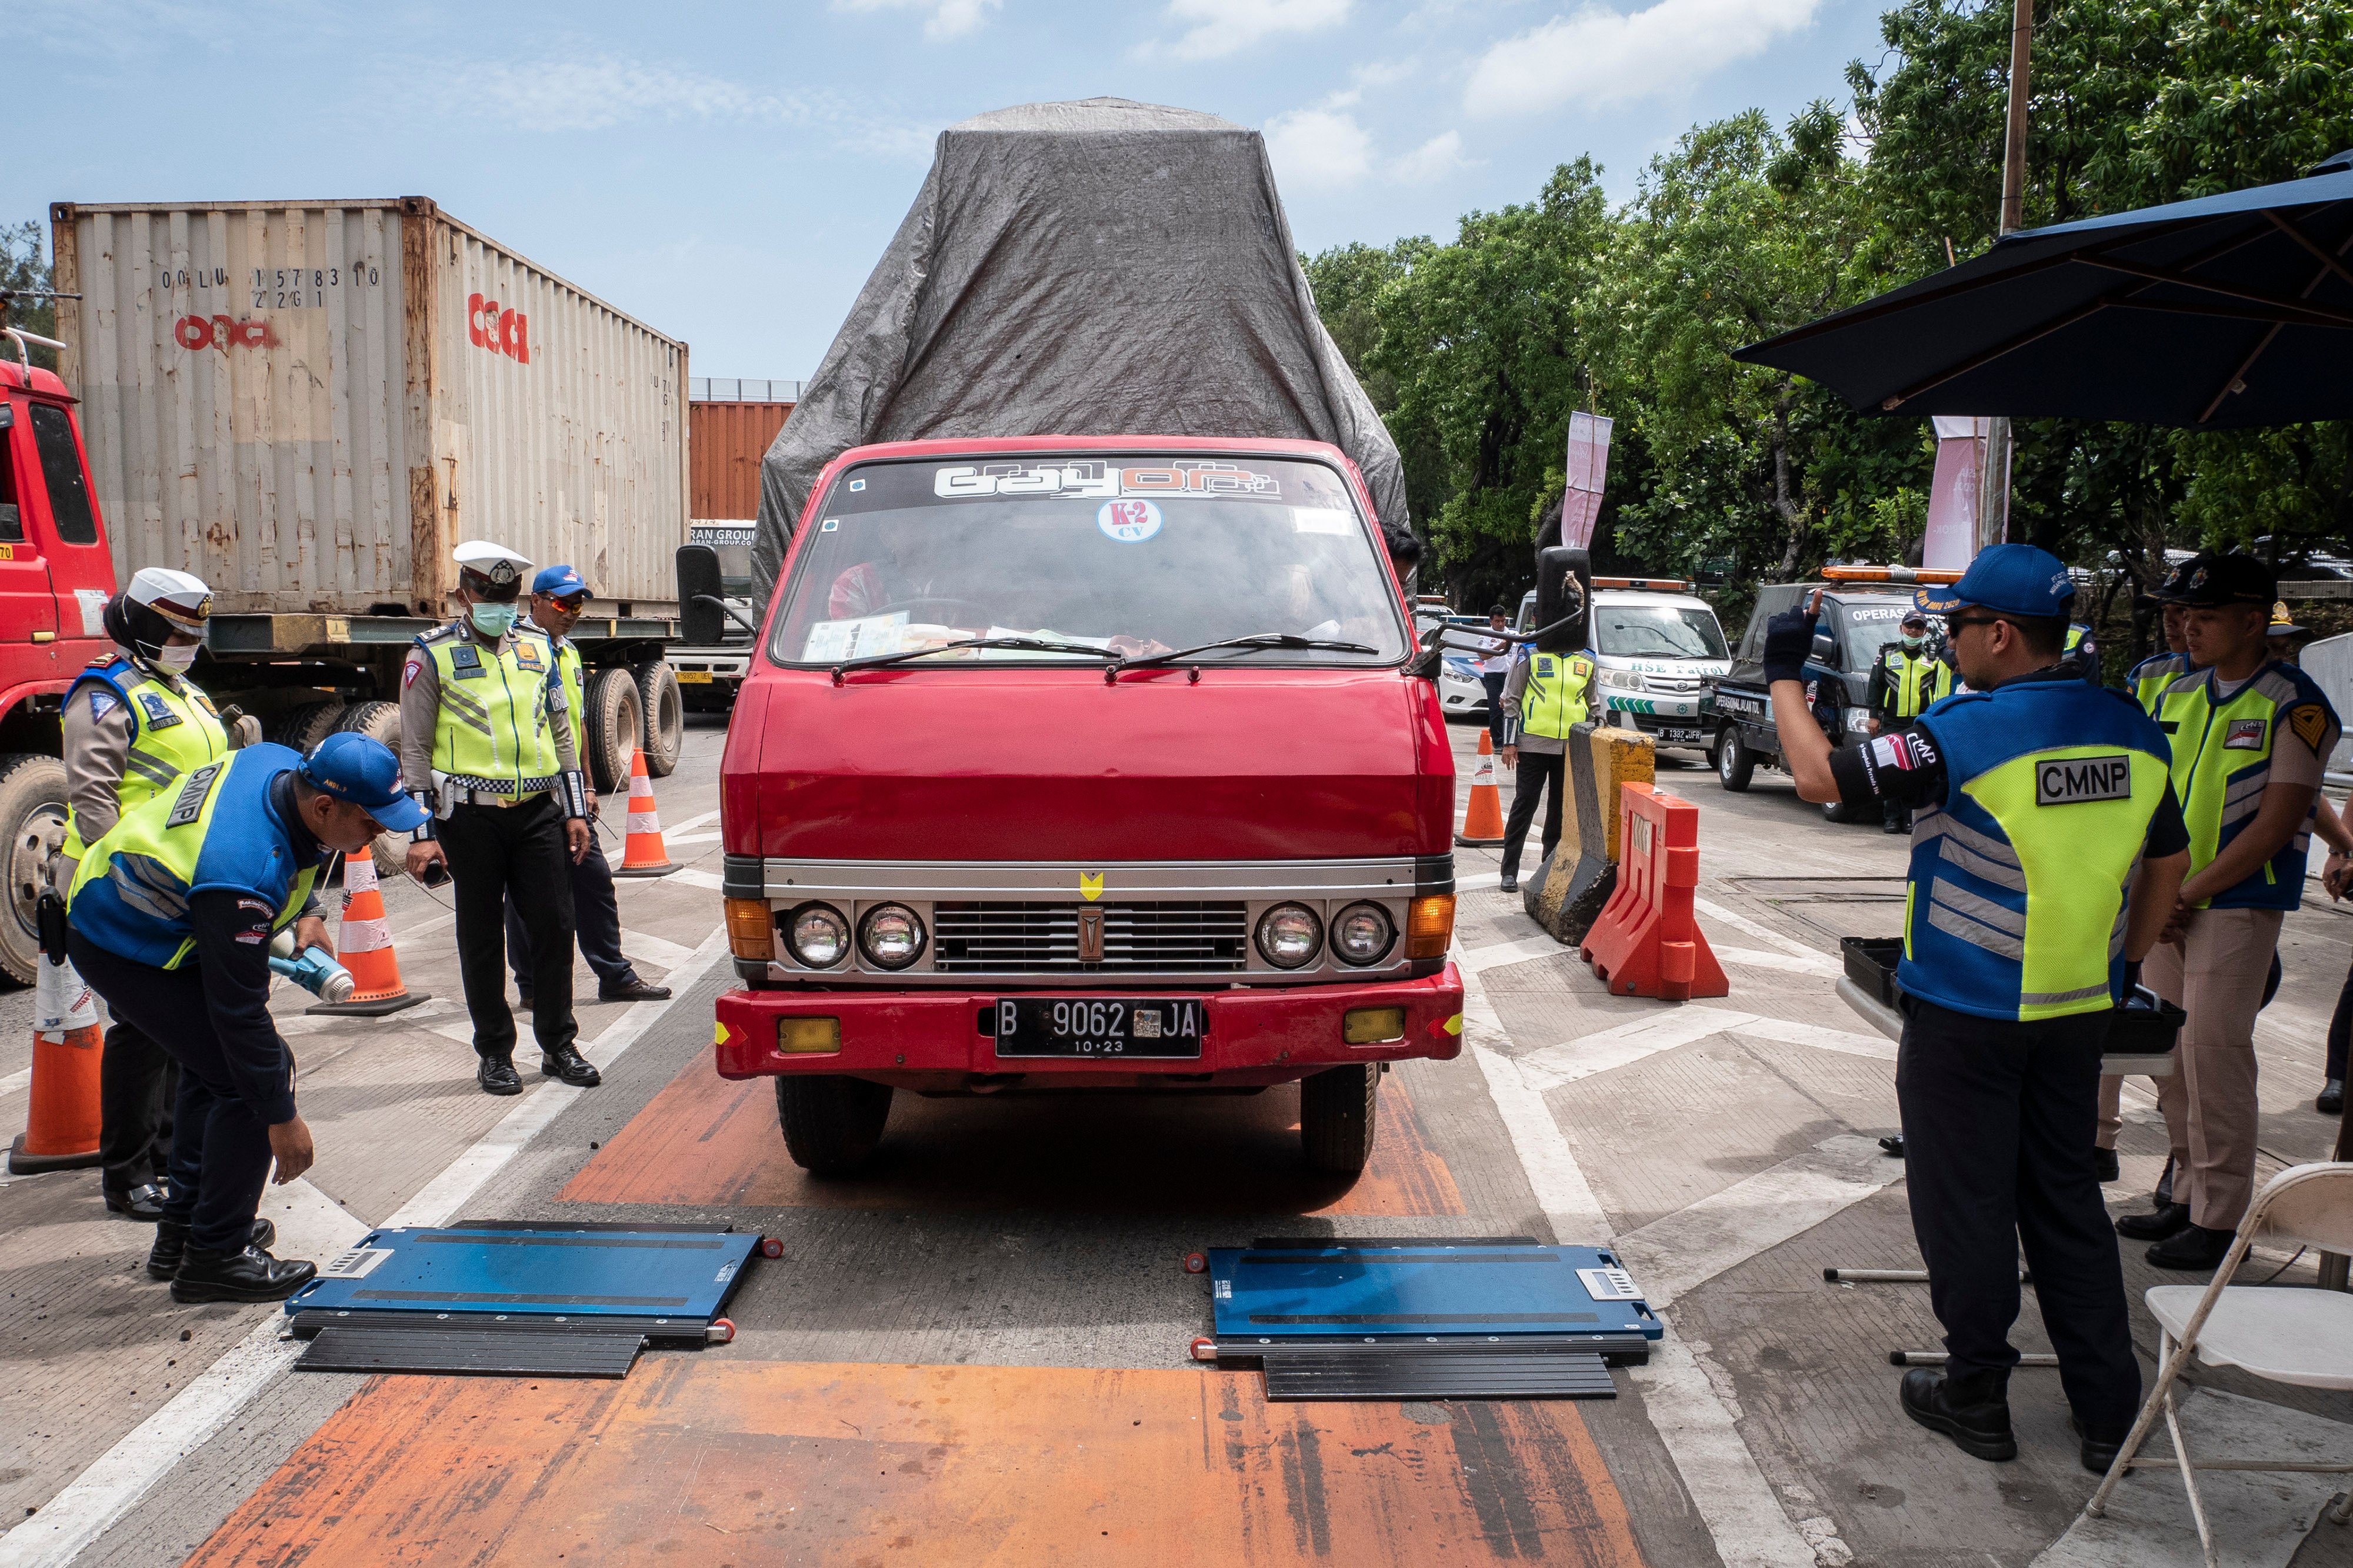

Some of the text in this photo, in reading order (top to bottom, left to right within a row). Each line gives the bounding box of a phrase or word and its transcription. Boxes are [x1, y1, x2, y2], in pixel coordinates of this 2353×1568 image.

[1109, 501, 1148, 525] K-2
[1118, 526, 1144, 538] CV
[1631, 663, 1667, 673] HSE
[1659, 729, 1664, 738] B
[1669, 730, 1685, 739] 1382
[1906, 733, 1937, 769] CMNP
[175, 767, 216, 820] CMNP
[2042, 762, 2127, 798] CMNP
[1001, 1002, 1017, 1035] B
[1054, 1002, 1125, 1037] 9062
[1163, 1002, 1197, 1037] JA
